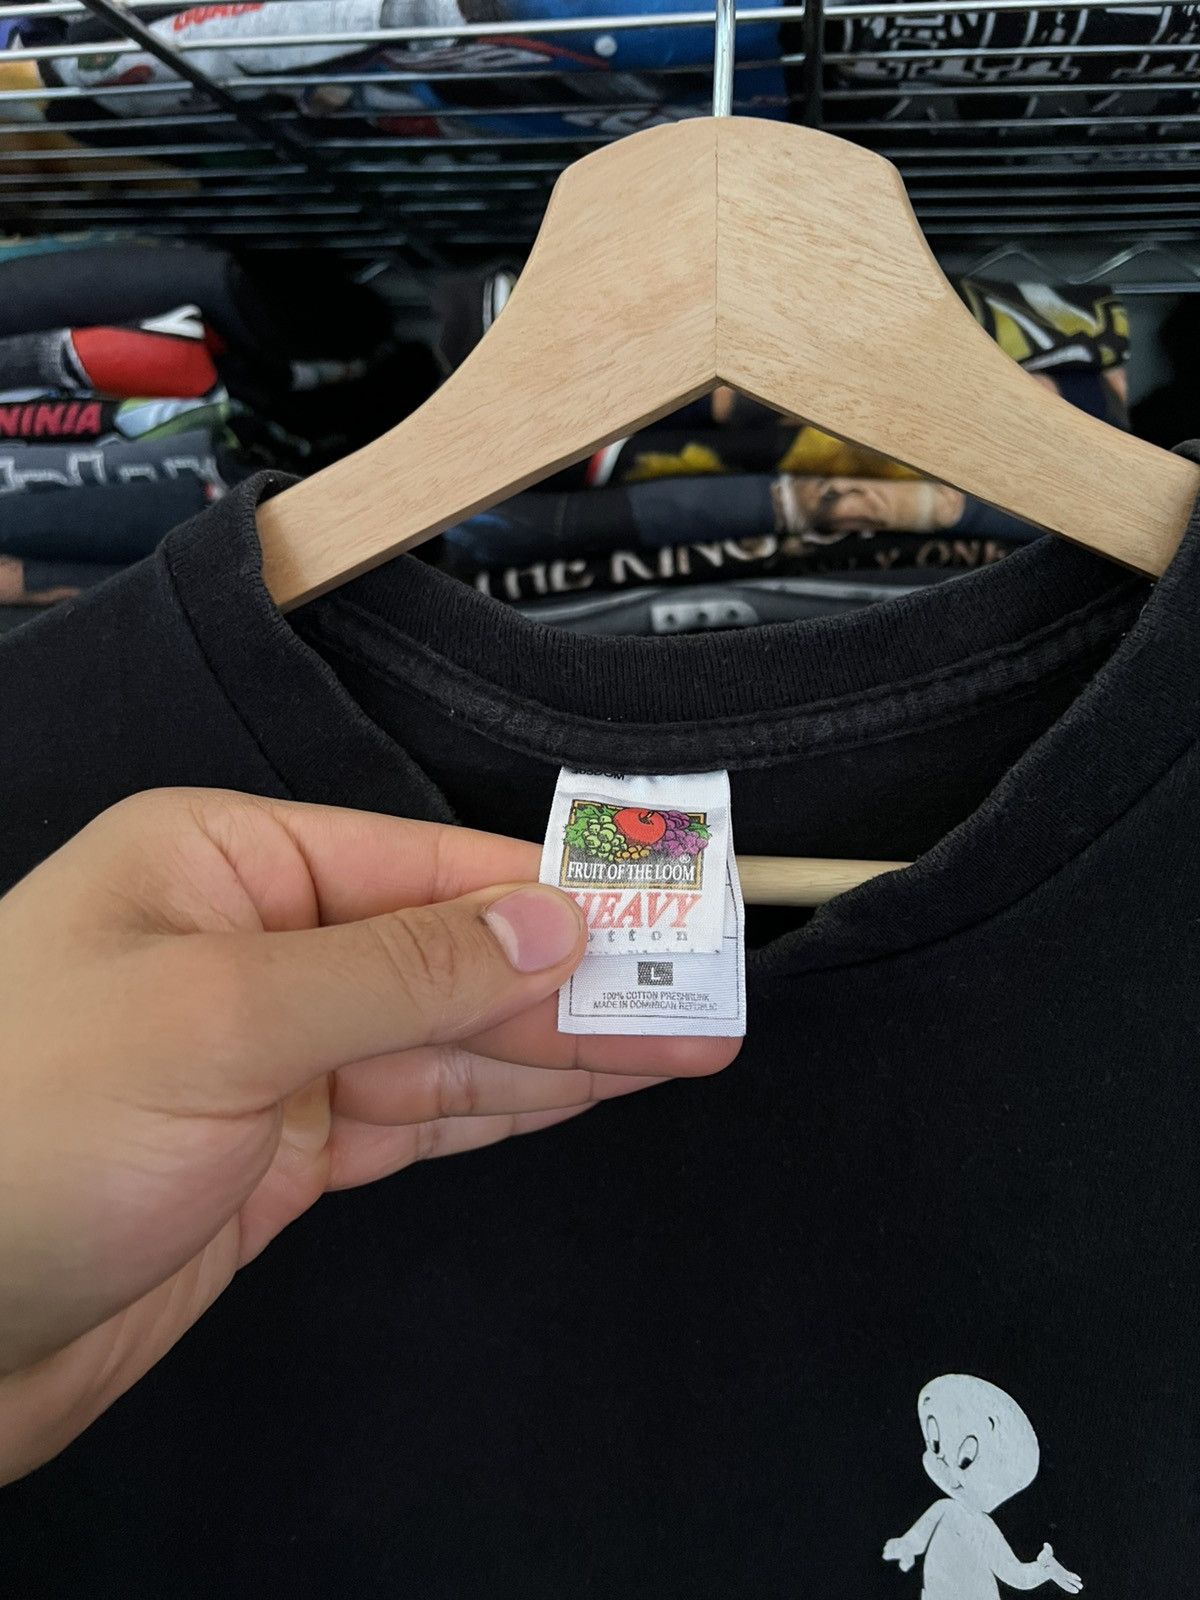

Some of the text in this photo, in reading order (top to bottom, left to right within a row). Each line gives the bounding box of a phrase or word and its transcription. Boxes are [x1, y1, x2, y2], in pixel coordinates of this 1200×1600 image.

[0, 402, 101, 436] NINJA
[567, 861, 695, 880] FRUIT OF THE LOOM
[588, 929, 688, 941] tton
[651, 967, 661, 980] L
[603, 992, 624, 1000] 100%
[626, 991, 658, 1001] COTTON
[593, 1000, 718, 1011] MADE IN DOMINICAN REPUBLIC
